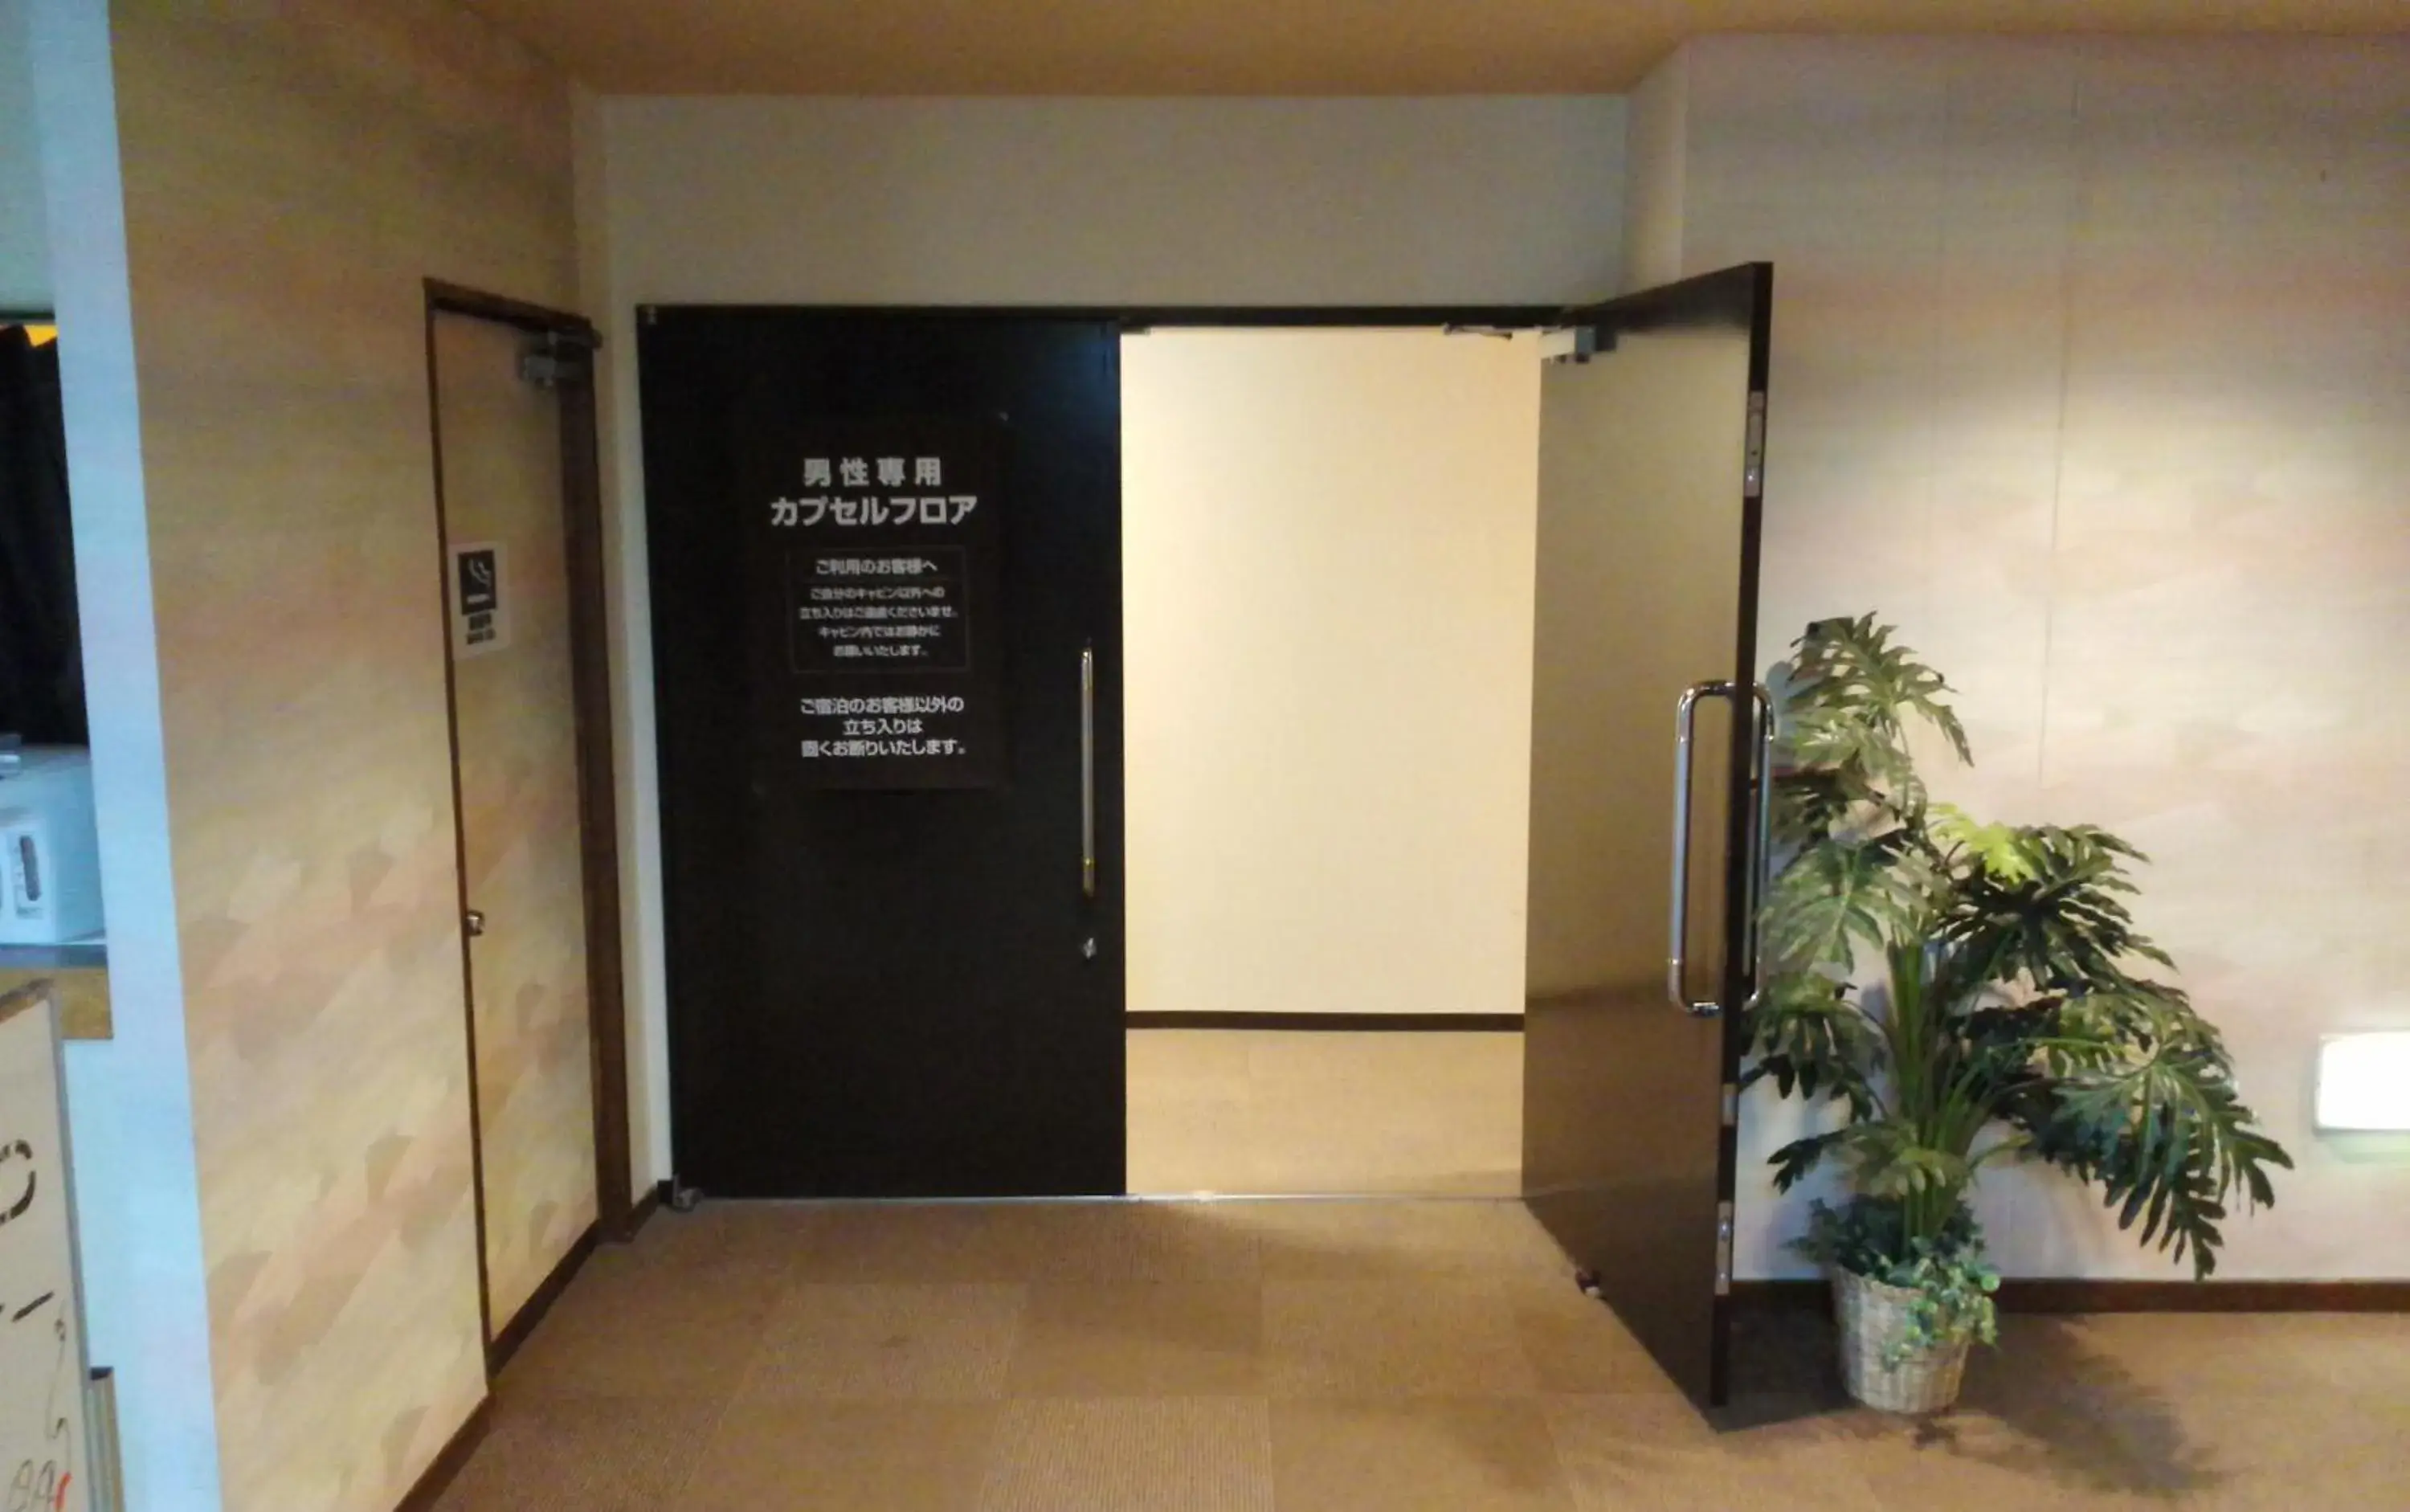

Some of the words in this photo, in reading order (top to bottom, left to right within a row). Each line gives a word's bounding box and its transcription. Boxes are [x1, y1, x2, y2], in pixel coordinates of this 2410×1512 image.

[770, 496, 978, 526] カプセルフロア
[816, 558, 938, 575] ご利用のお客様へ
[801, 697, 965, 714] ご宿泊のお客様以外の
[843, 718, 924, 736] 立ち入りは
